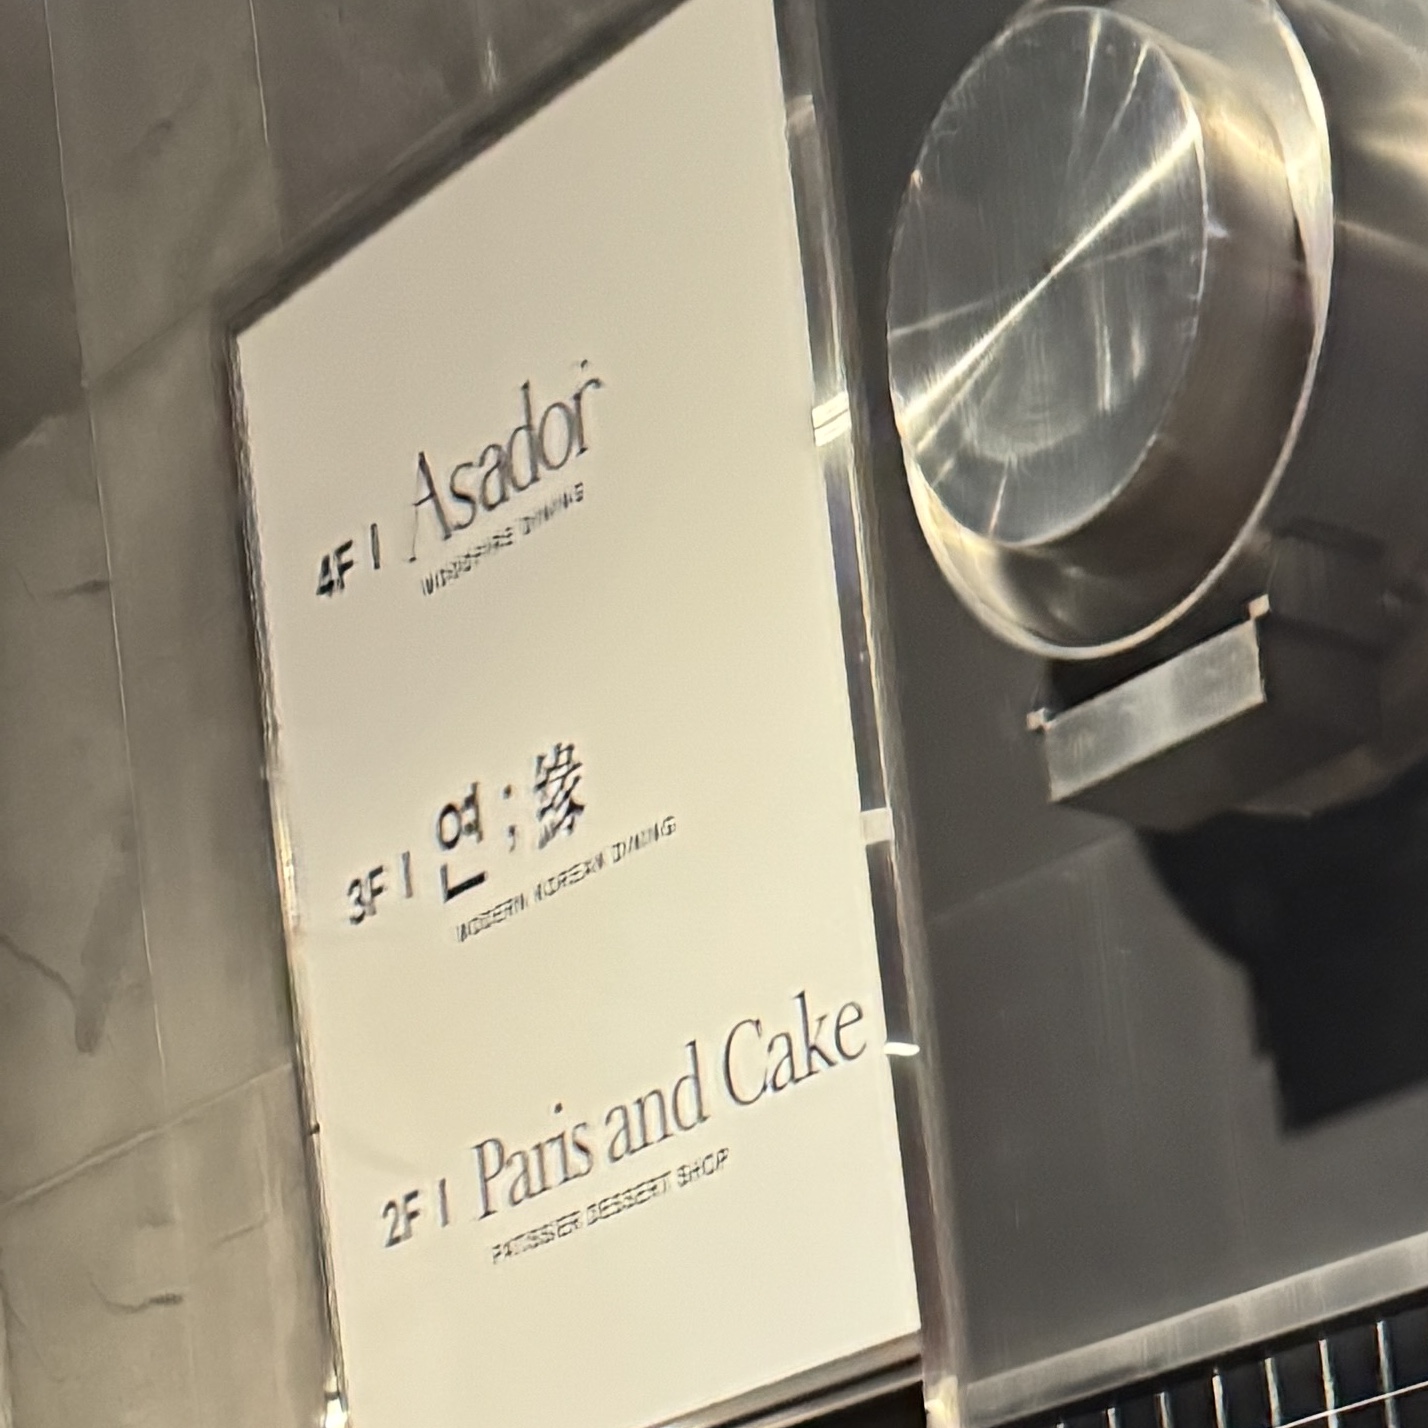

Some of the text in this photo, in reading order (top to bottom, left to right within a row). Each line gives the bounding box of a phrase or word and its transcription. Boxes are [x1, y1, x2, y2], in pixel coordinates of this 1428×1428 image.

[316, 539, 354, 598] 4F
[609, 815, 678, 864] DINING
[347, 864, 385, 924] 3F
[381, 1189, 422, 1248] 2F
[471, 1100, 595, 1222] Paris
[605, 1038, 711, 1165] and
[722, 989, 869, 1107] Cake
[677, 1146, 730, 1188] SHOP
